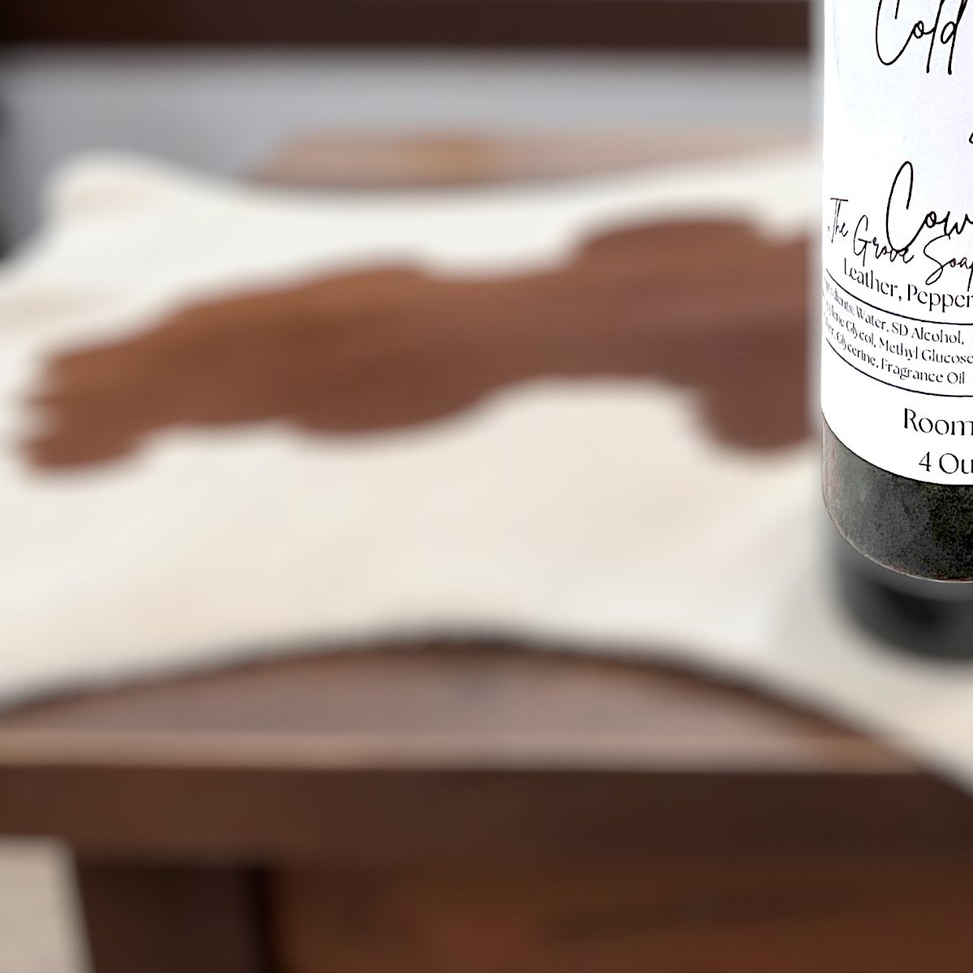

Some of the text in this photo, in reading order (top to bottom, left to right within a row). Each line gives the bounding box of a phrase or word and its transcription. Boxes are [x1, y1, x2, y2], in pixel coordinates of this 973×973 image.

[827, 197, 849, 243] The
[853, 214, 914, 267] Grove
[843, 257, 902, 302] Leather,
[891, 321, 909, 337] SD
[879, 337, 918, 361] Methyl
[881, 357, 944, 381] Fragrance
[946, 371, 965, 384] Oil
[918, 450, 932, 473] 4
